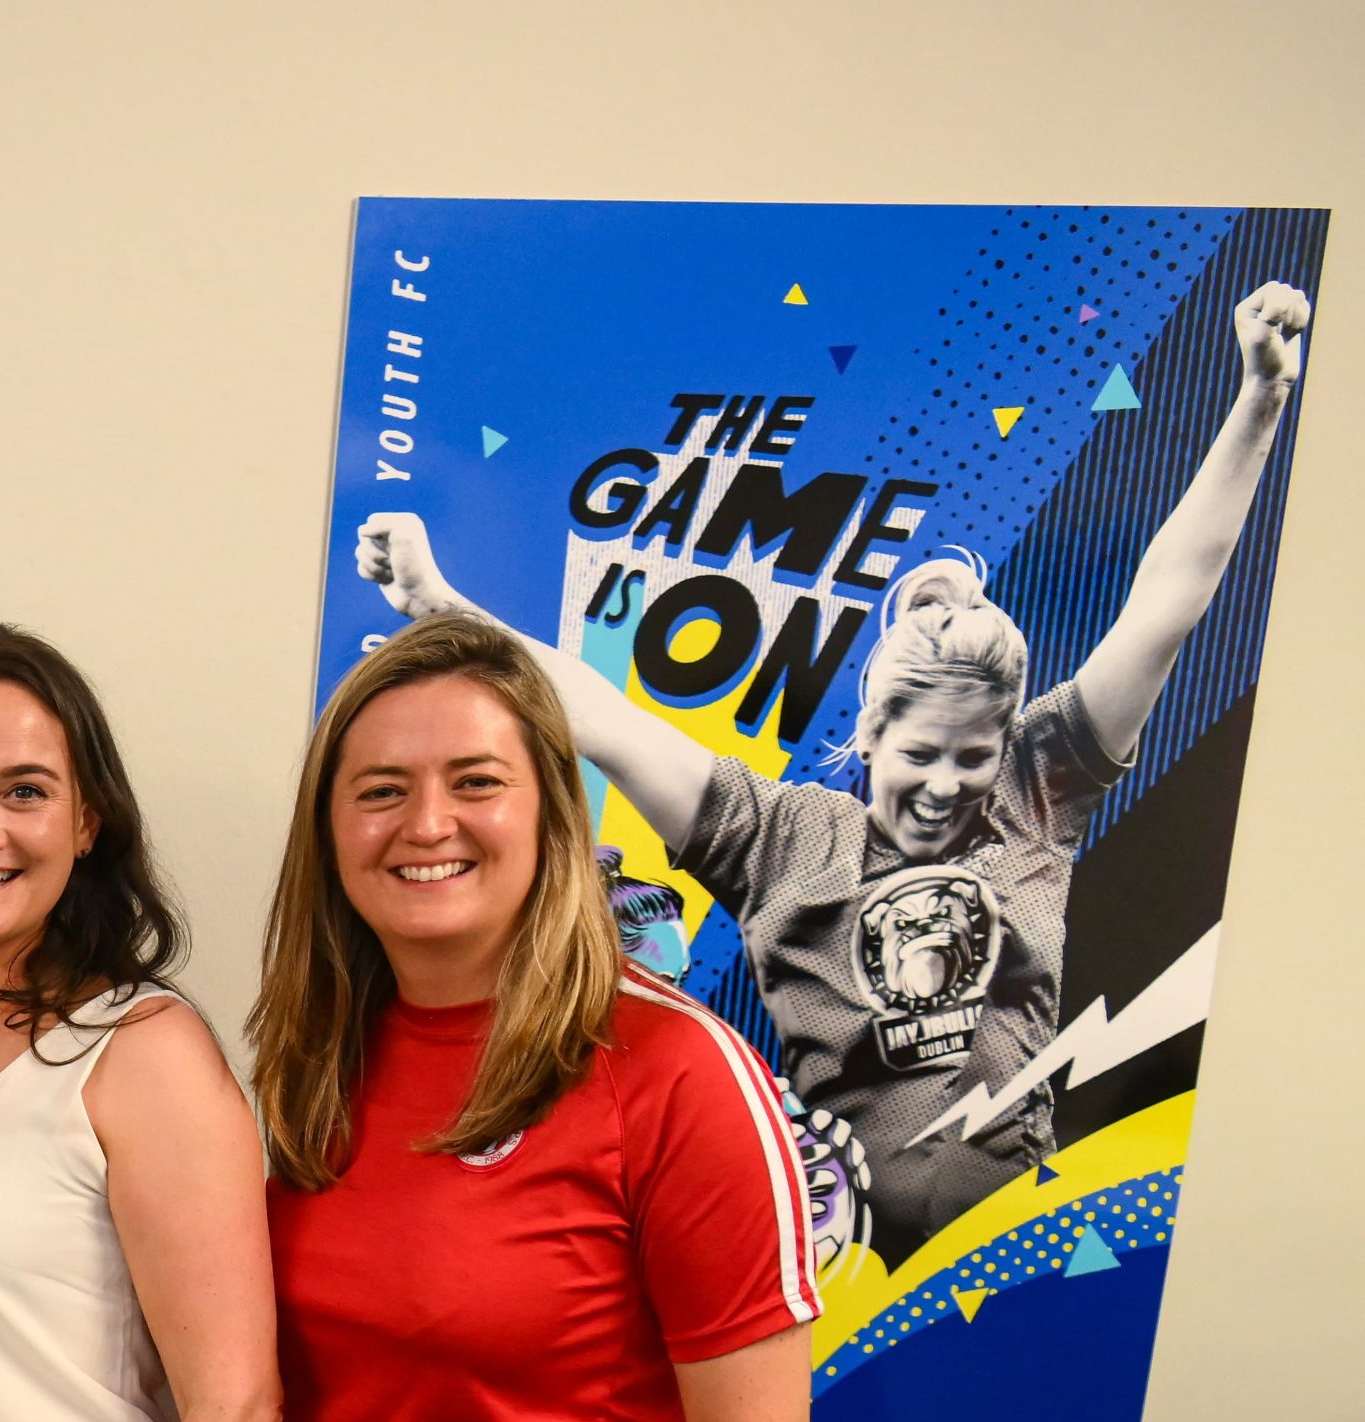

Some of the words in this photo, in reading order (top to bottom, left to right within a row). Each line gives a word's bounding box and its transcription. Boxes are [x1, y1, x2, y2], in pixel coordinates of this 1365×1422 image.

[392, 250, 430, 302] FC
[376, 331, 423, 481] YOUTH
[664, 393, 816, 455] THE
[570, 448, 939, 590] GAME
[585, 563, 646, 624] IS
[633, 574, 870, 743] ON
[917, 1035, 965, 1058] DUBLIN
